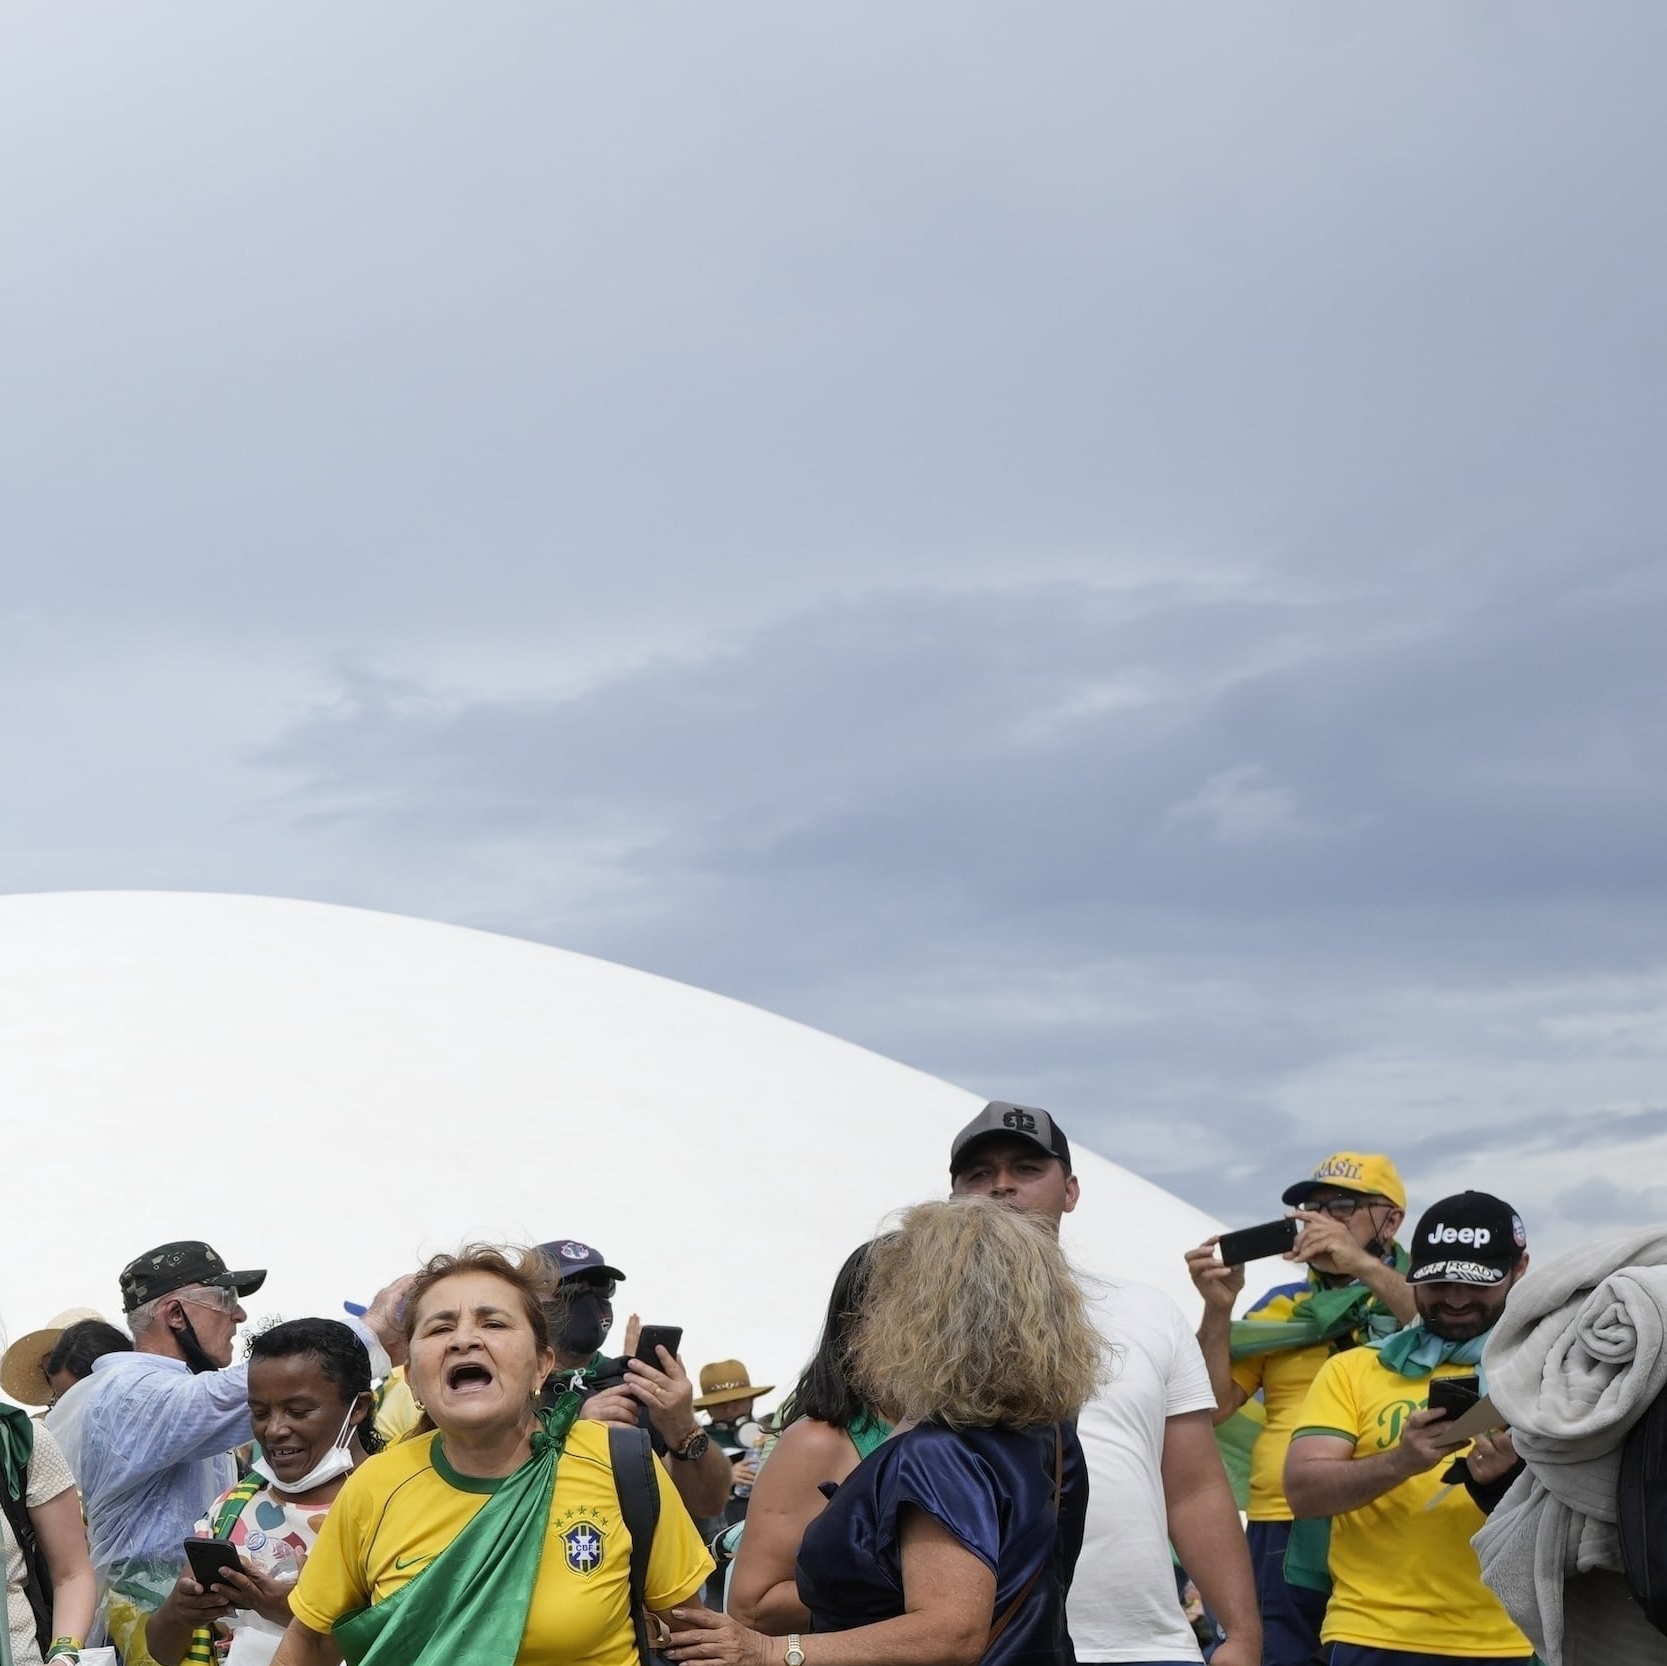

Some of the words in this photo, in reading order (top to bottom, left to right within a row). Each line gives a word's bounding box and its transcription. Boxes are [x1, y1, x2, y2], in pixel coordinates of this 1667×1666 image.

[1428, 1223, 1491, 1248] Jeep
[1446, 1261, 1495, 1280] ROAD
[576, 1544, 594, 1552] CBF
